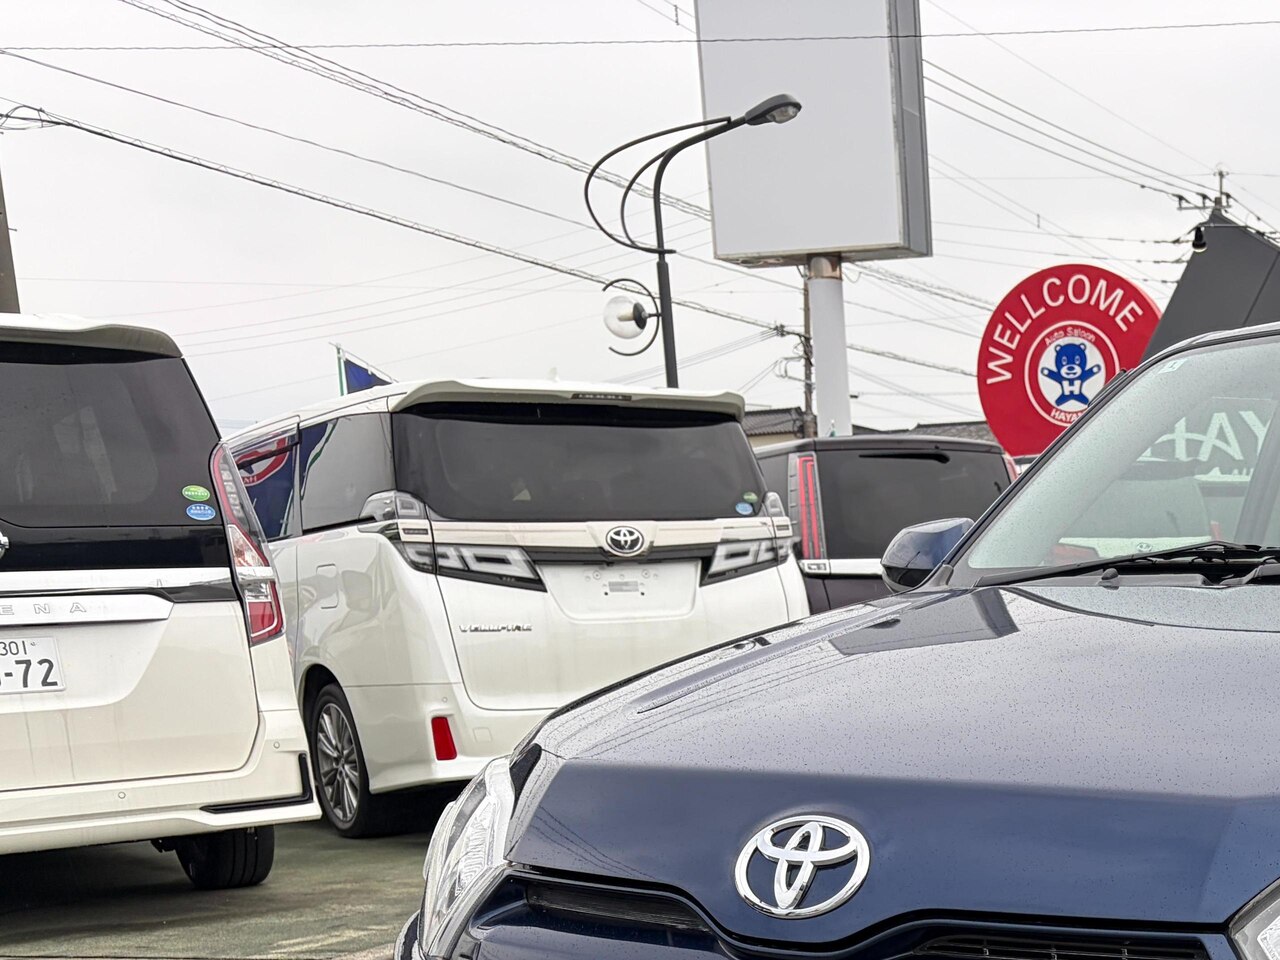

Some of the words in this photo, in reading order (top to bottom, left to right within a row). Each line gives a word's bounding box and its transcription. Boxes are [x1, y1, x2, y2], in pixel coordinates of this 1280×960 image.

[986, 274, 1144, 385] WELLCOME
[1044, 330, 1065, 346] Auto
[1066, 326, 1096, 342] Saloon
[1062, 380, 1081, 396] H
[1050, 408, 1084, 423] HAYA
[0, 658, 59, 689] -72
